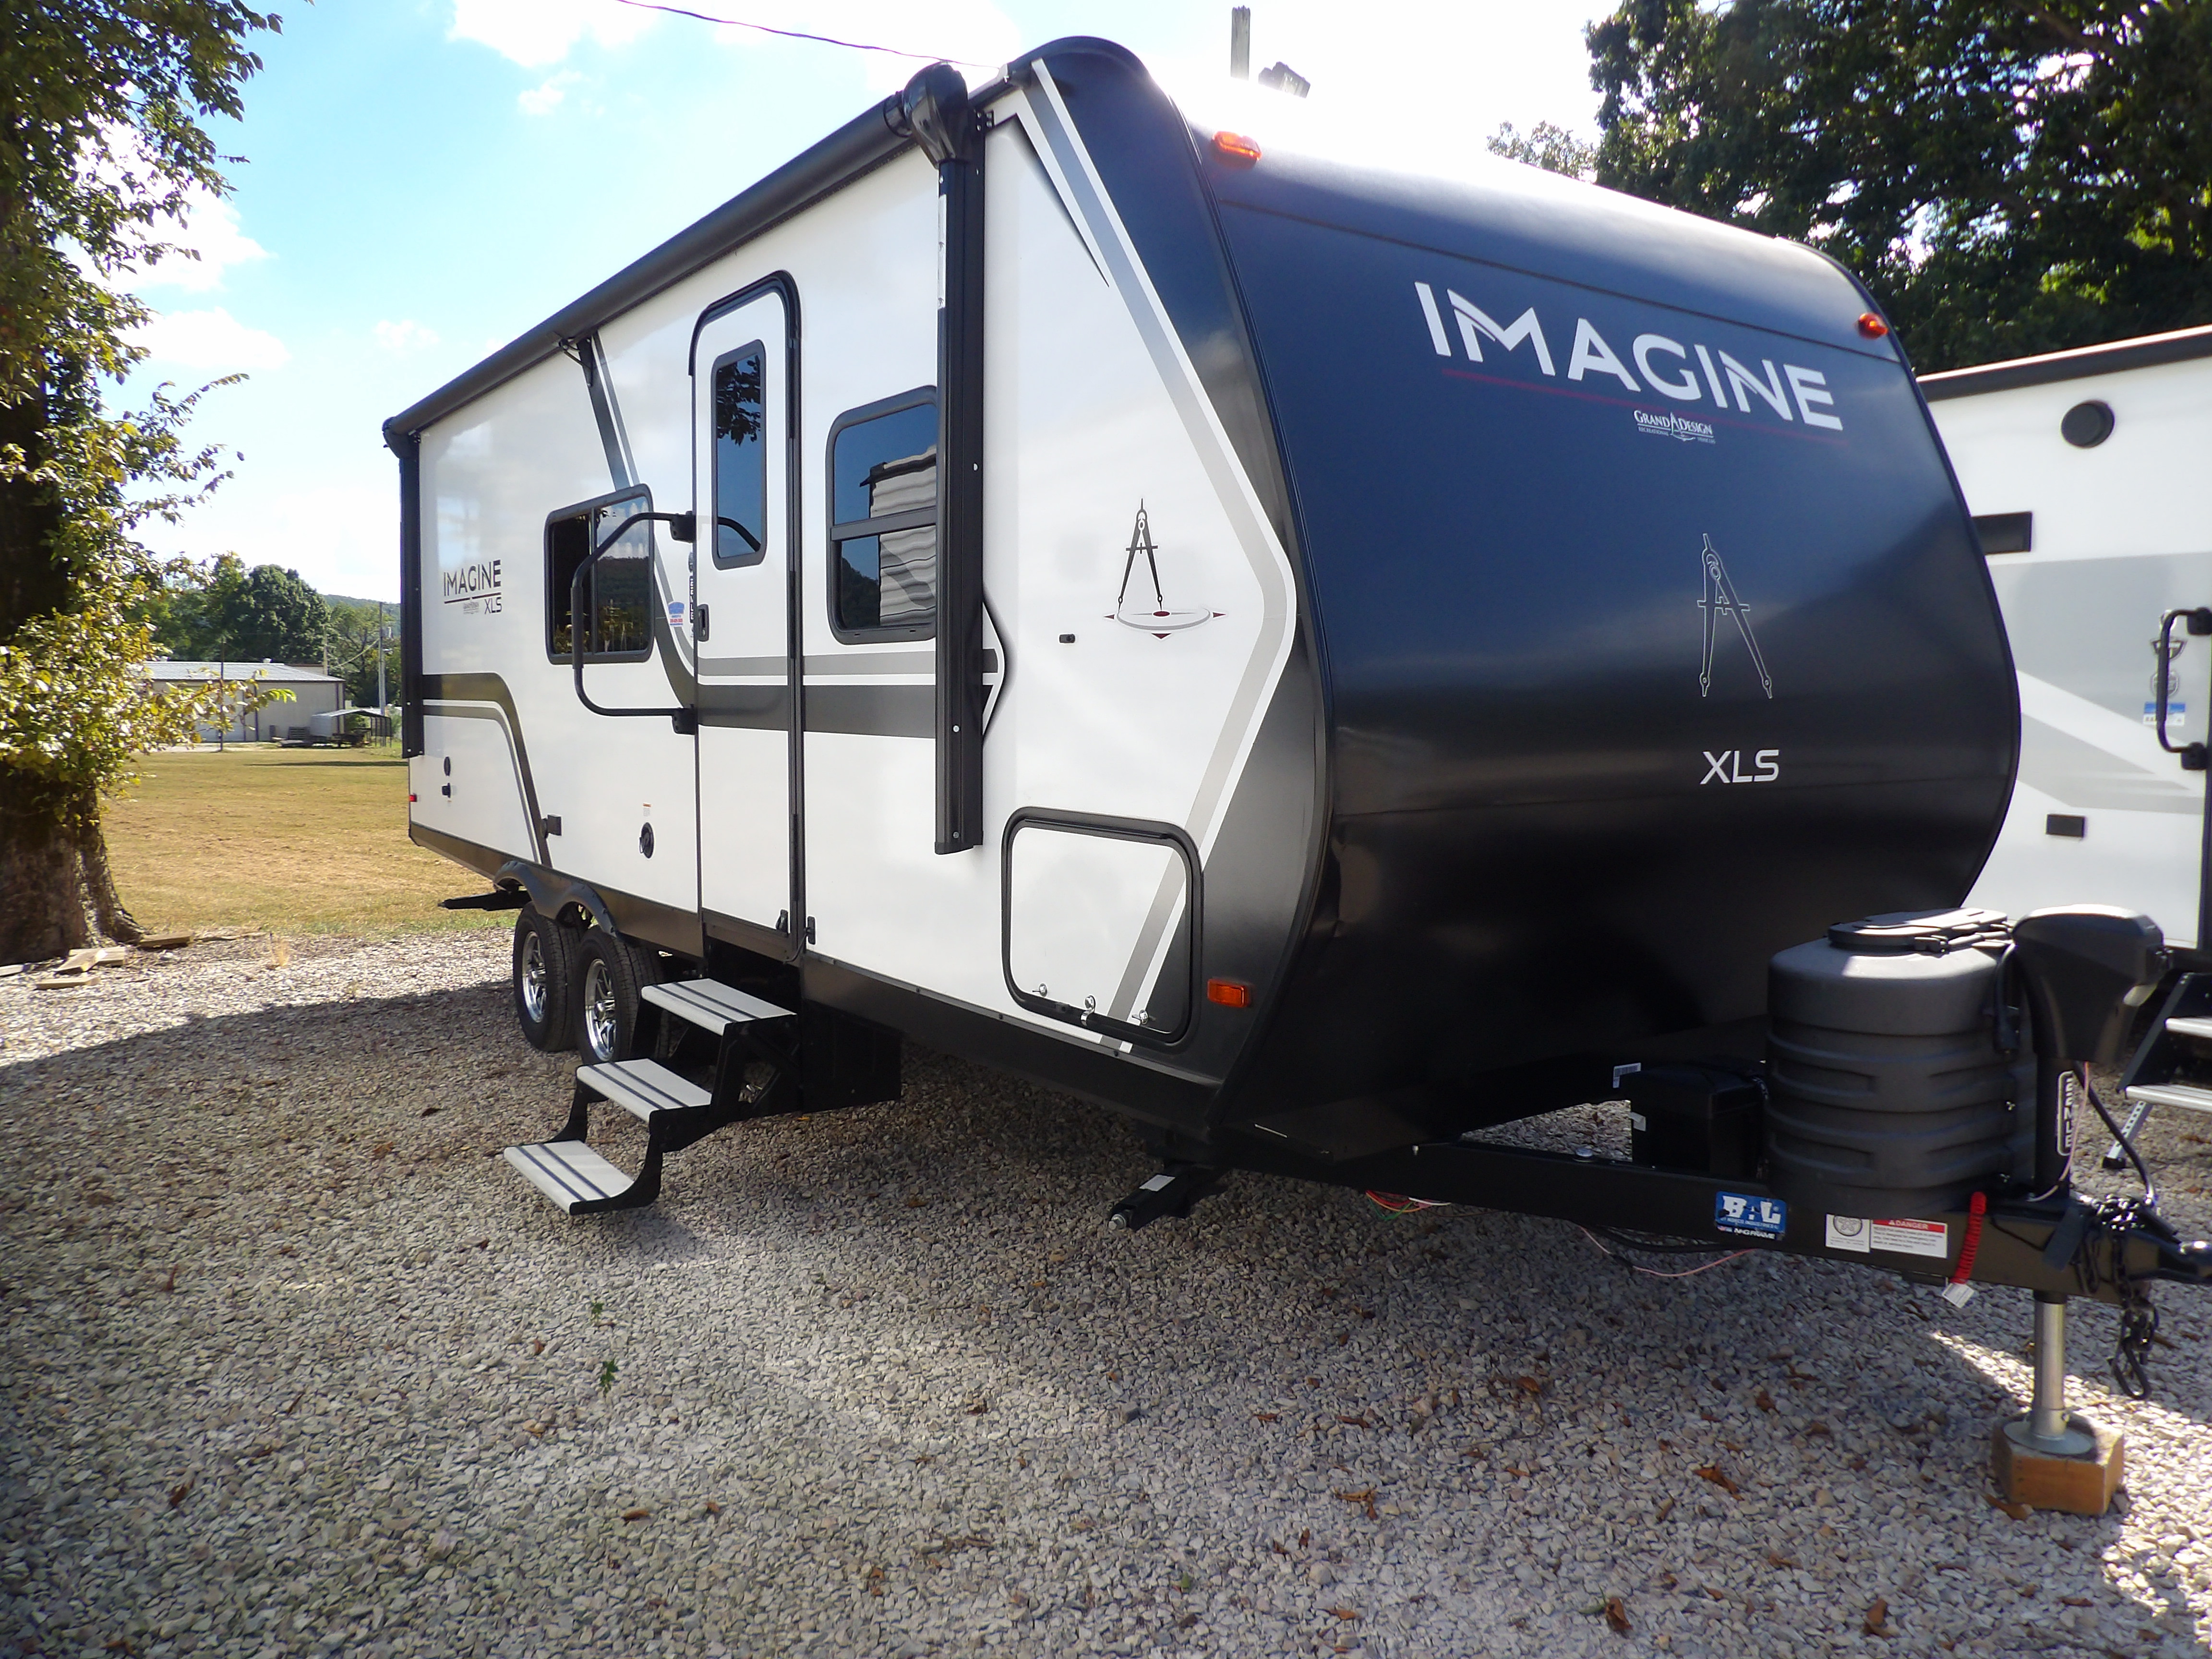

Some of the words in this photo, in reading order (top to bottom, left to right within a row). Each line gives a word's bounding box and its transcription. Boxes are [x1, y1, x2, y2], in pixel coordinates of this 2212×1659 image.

[1414, 281, 1843, 431] IMAGINE
[1634, 409, 1671, 427] GRAND
[1678, 416, 1713, 435] DESIGN
[444, 559, 501, 596] IMAGINE
[484, 596, 502, 614] XLS
[1699, 749, 1779, 784] XLS
[1896, 1220, 1929, 1230] DANGER
